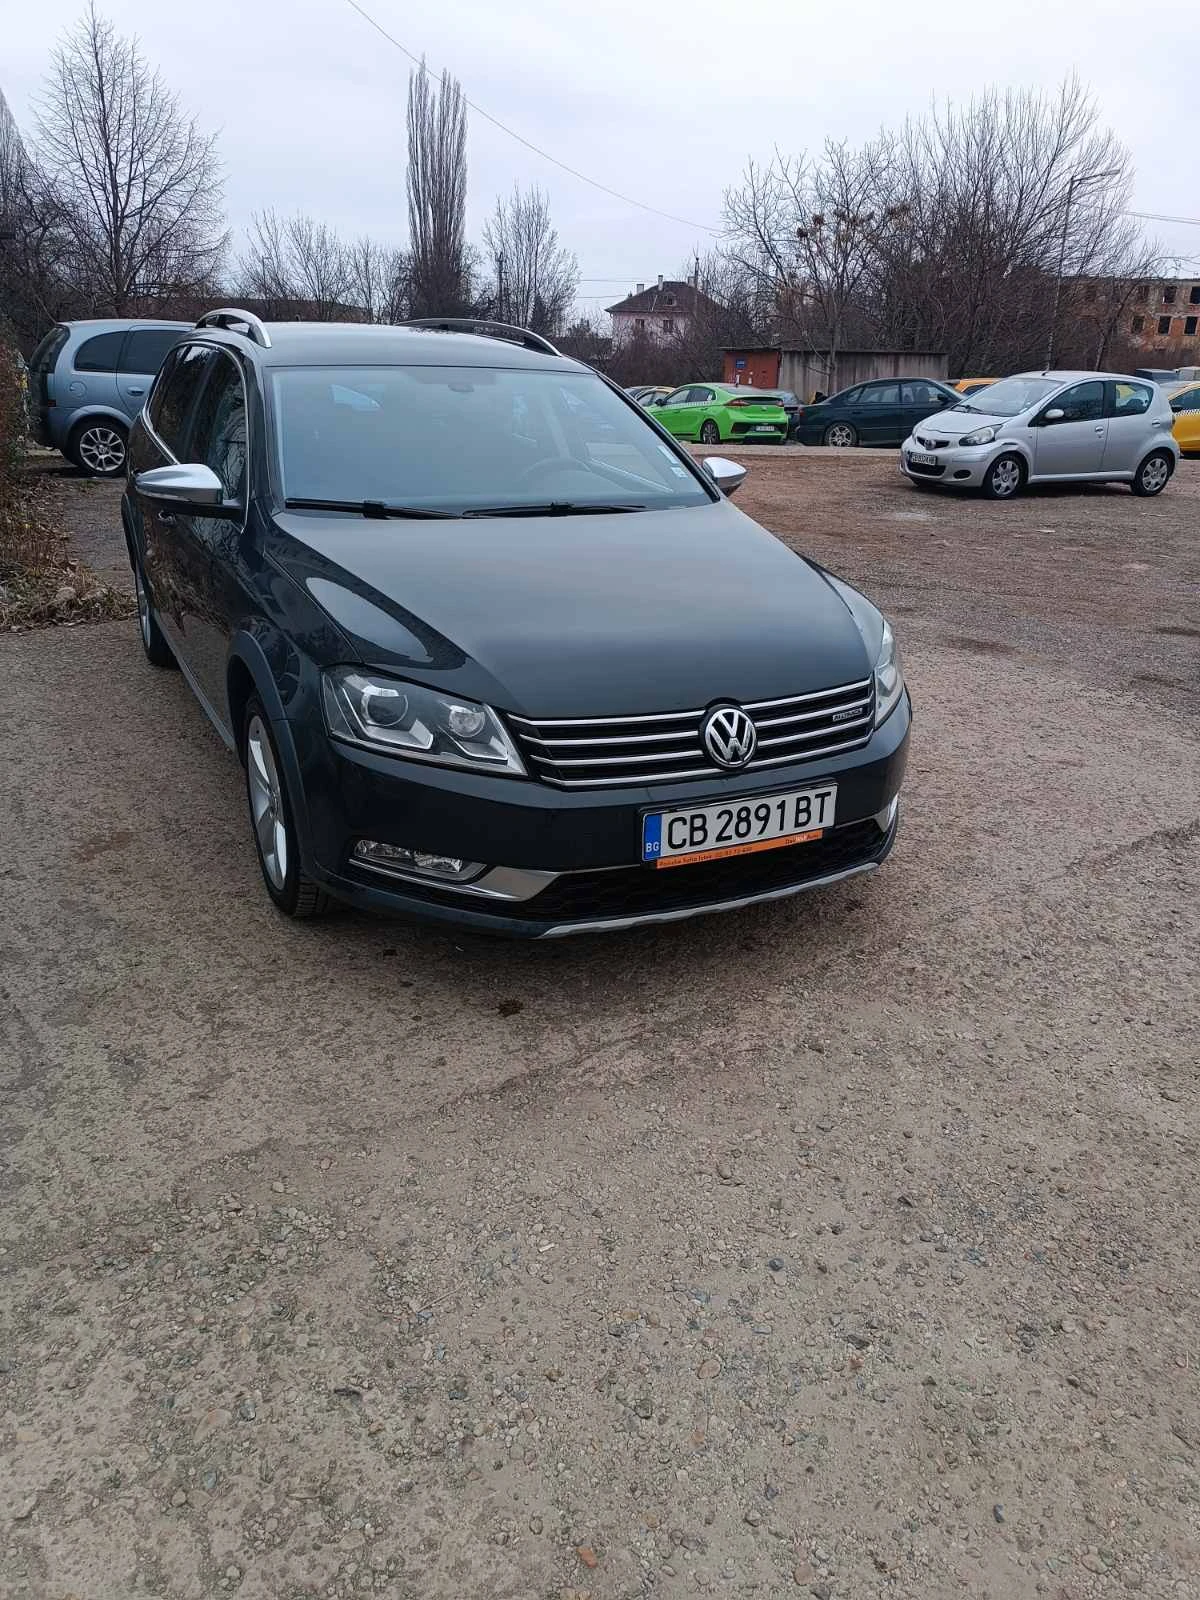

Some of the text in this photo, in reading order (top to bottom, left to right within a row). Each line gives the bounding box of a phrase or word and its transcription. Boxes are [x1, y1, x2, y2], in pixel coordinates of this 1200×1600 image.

[667, 813, 709, 850] CB
[715, 799, 787, 843] 2891
[794, 791, 832, 829] BT
[645, 841, 660, 853] BG
